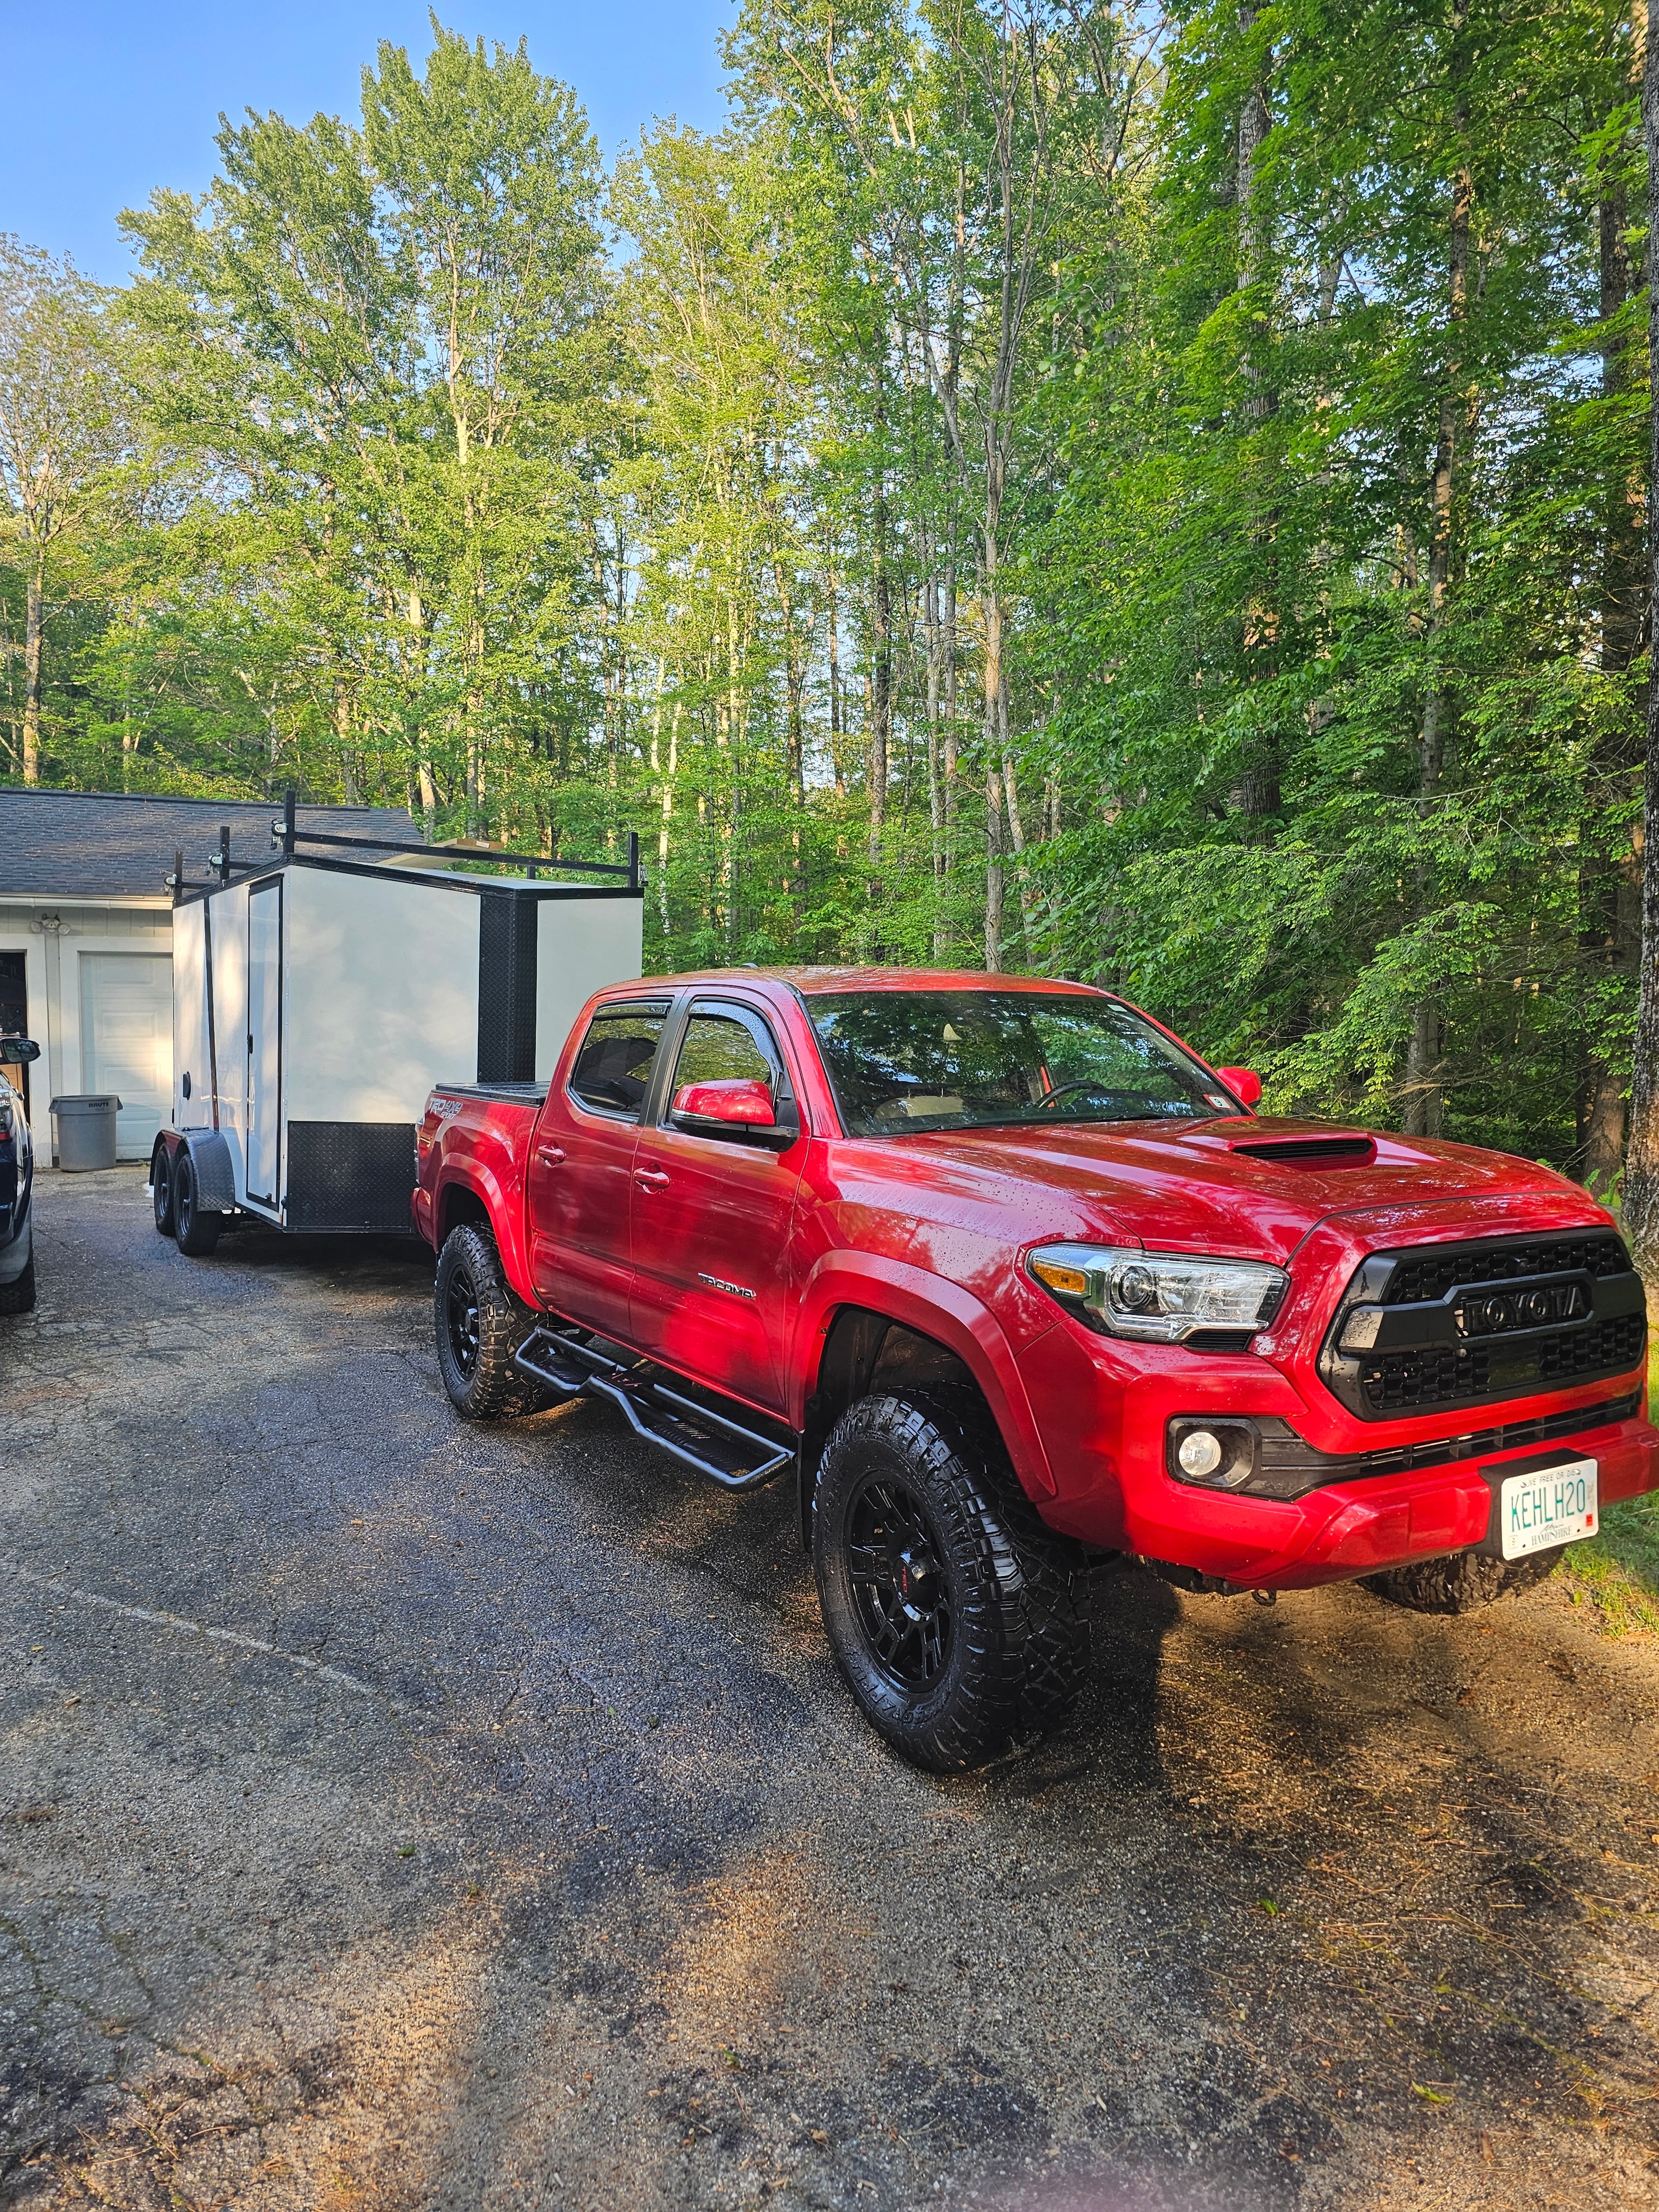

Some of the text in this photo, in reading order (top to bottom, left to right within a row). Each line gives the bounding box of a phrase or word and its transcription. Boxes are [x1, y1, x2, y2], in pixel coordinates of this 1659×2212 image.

[429, 1097, 446, 1115] TRD
[439, 1111, 457, 1120] SPORT
[698, 1272, 757, 1301] TACOMA
[1464, 1285, 1587, 1331] TOYOTA
[1540, 1474, 1554, 1484] FREE
[1556, 1471, 1564, 1479] OR
[1532, 1525, 1573, 1546] HAMPSHIRE
